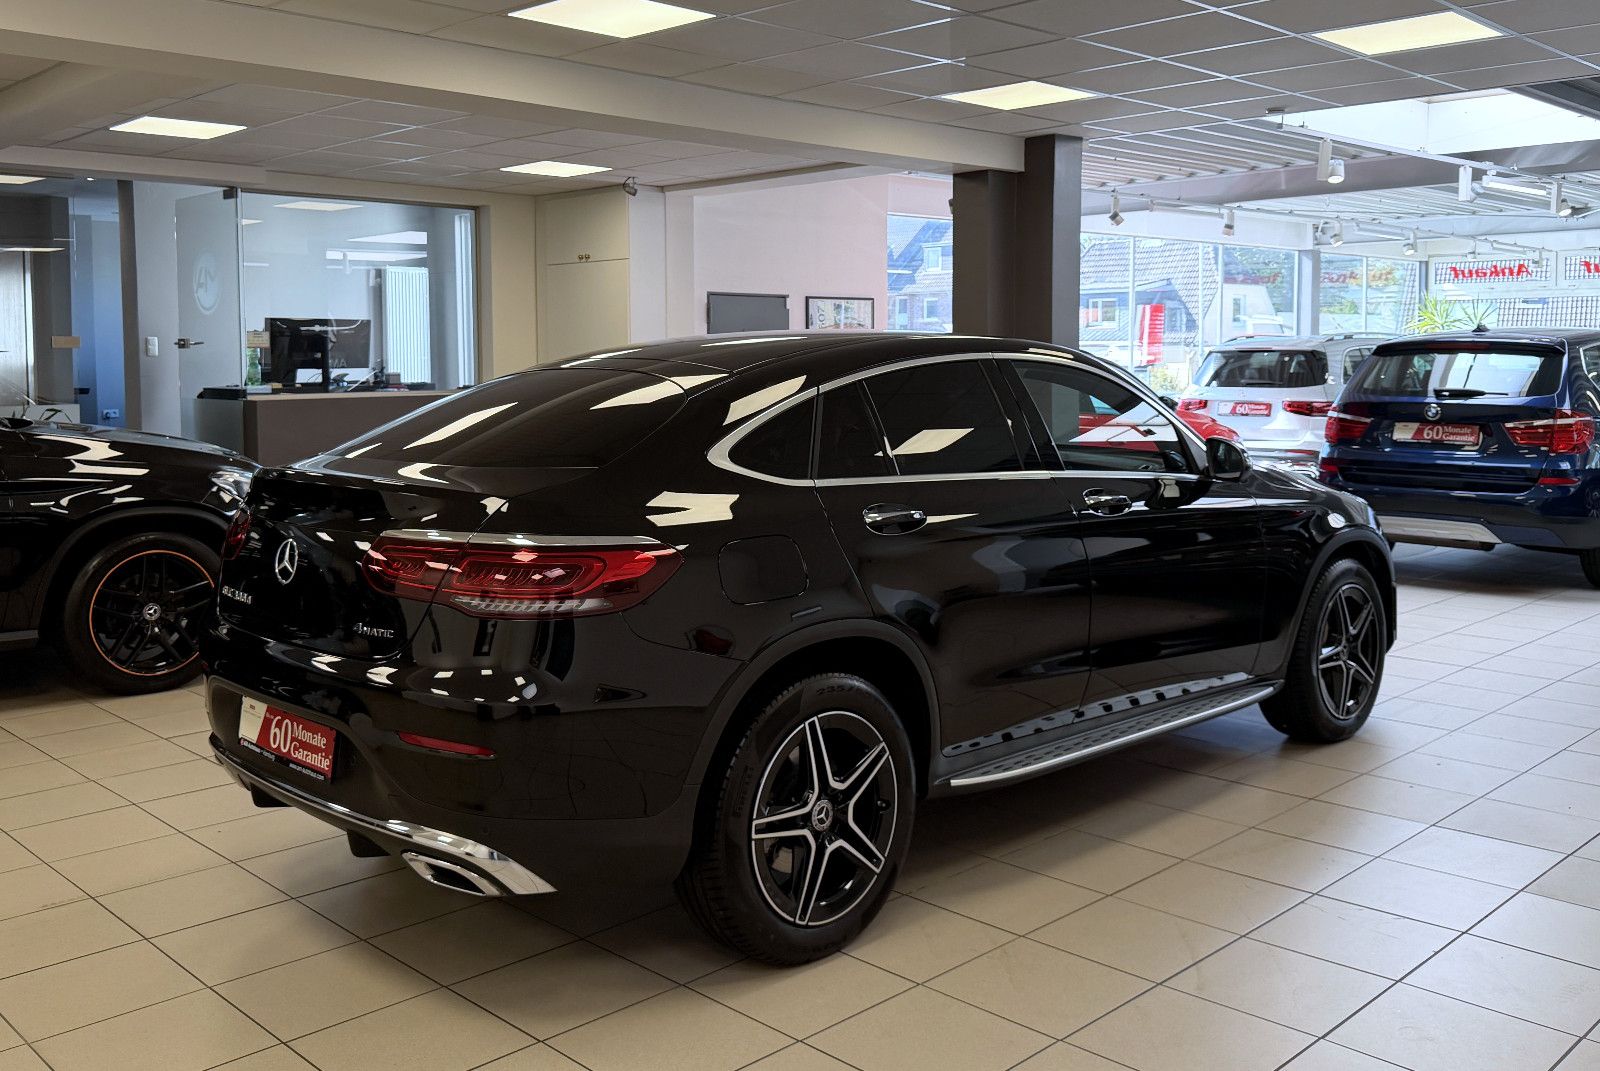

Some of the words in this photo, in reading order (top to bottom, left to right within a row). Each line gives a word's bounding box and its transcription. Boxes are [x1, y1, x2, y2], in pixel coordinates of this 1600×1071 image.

[1236, 403, 1249, 414] 60
[1423, 425, 1442, 440] 60
[1443, 426, 1472, 434] Monate
[270, 716, 292, 753] 60
[292, 721, 327, 749] Monate
